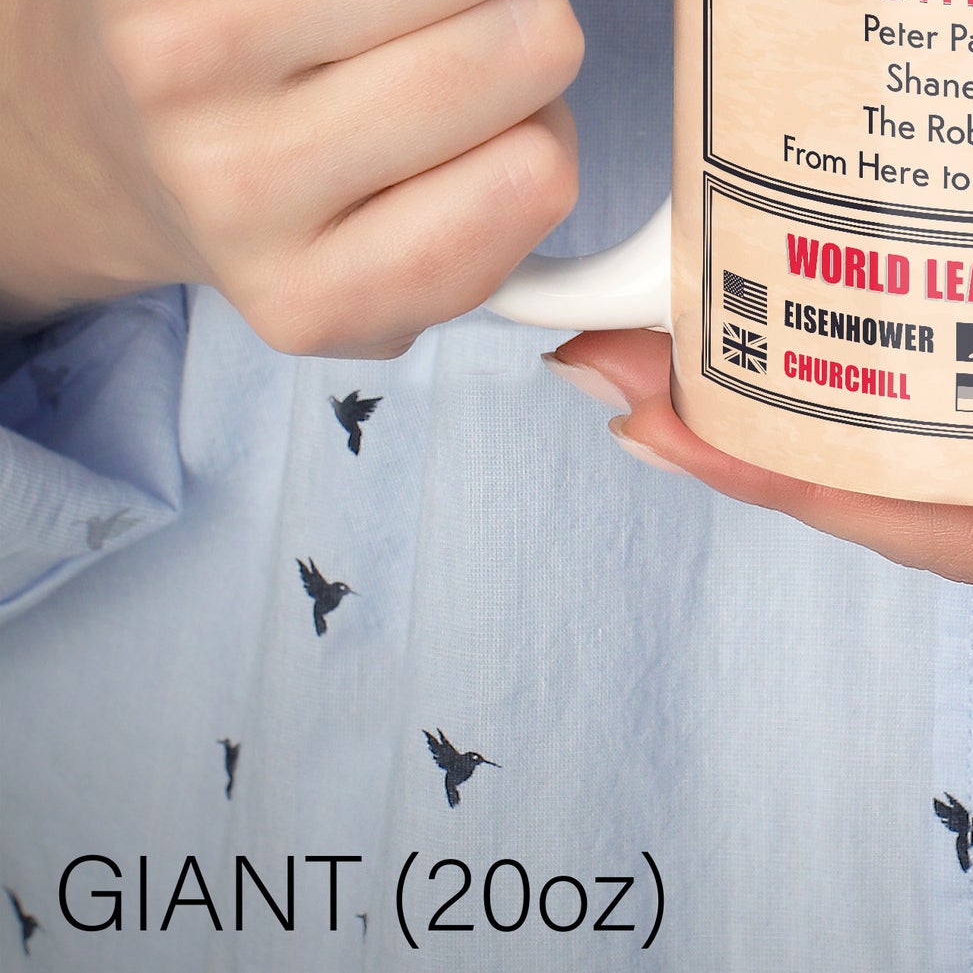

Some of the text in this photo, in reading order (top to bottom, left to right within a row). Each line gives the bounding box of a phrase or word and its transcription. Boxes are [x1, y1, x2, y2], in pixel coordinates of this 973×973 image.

[864, 14, 938, 50] Peter
[863, 106, 915, 140] The
[784, 135, 847, 176] From
[859, 151, 929, 187] Here
[943, 166, 970, 191] to
[786, 233, 910, 296] WORLD
[784, 300, 935, 354] EISENHOWER
[783, 350, 910, 400] CHURCHILL
